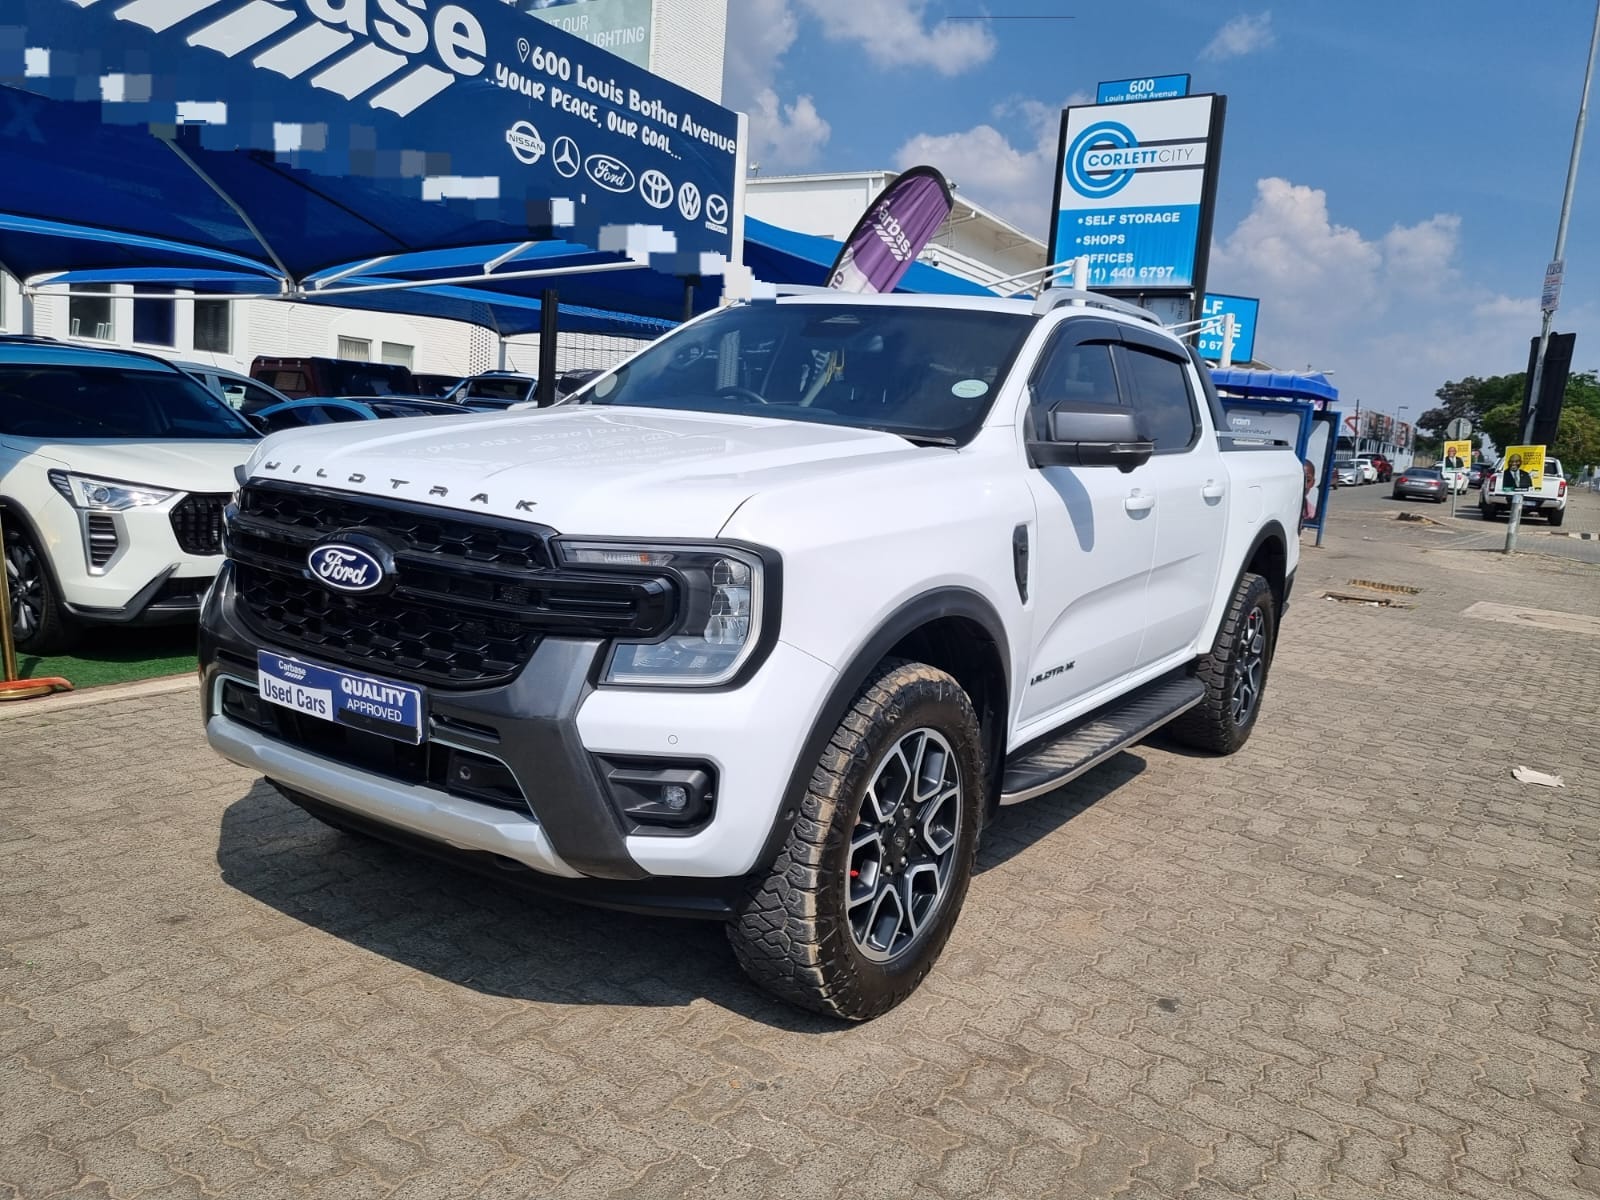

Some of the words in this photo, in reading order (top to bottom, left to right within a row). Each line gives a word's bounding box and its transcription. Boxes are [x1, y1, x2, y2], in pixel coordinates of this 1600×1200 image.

[563, 15, 589, 33] OUR
[1129, 79, 1155, 94] 600
[532, 46, 571, 81] 600
[577, 64, 624, 105] Louis
[629, 88, 678, 129] Botha
[681, 113, 736, 154] Avenue
[1105, 94, 1124, 102] Louis
[1125, 93, 1148, 101] Botha
[1149, 90, 1178, 98] Avenue
[607, 111, 638, 139] OUR
[508, 133, 545, 152] NISSAN
[594, 159, 627, 187] Ford
[1119, 212, 1181, 224] STORAGE
[1110, 267, 1136, 278] 440
[1139, 266, 1175, 278] 6797
[1203, 299, 1224, 315] LF
[1200, 320, 1242, 338] AGE
[320, 549, 368, 585] Ford
[278, 660, 307, 676] Carbase
[264, 677, 293, 704] Used
[296, 689, 326, 715] Cars
[341, 678, 406, 707] QUALITY
[347, 698, 403, 722] APPROVED
